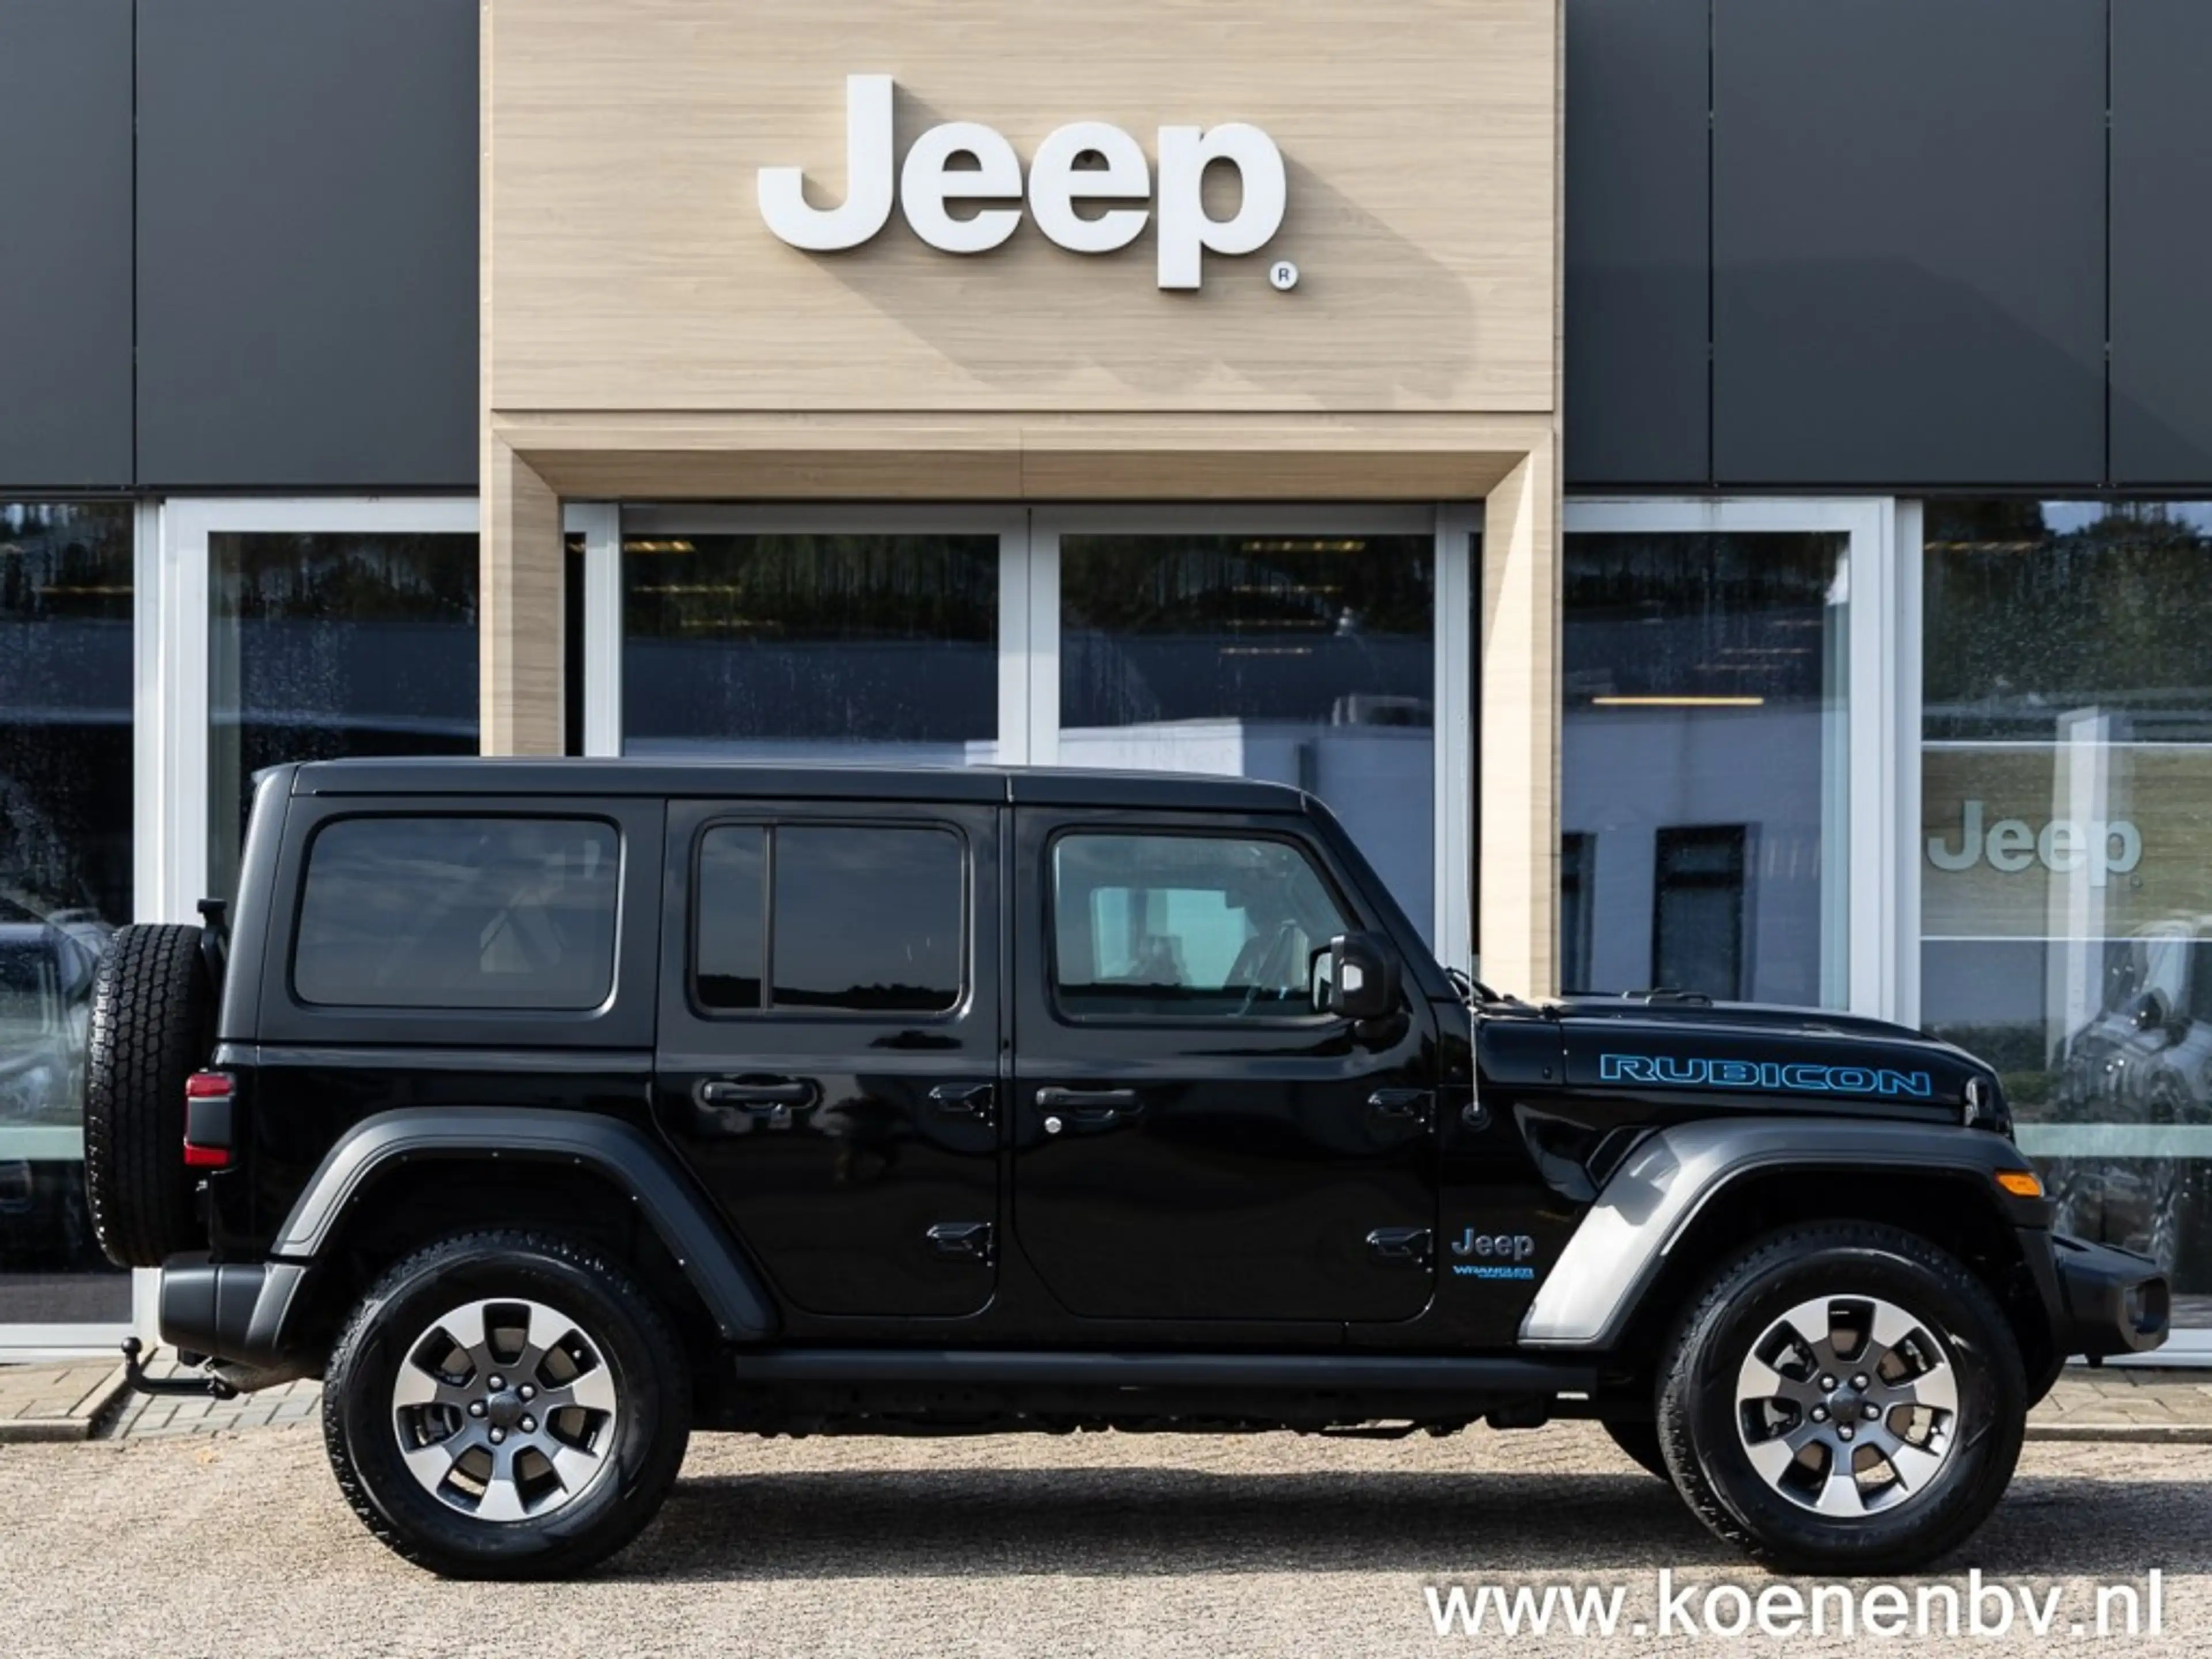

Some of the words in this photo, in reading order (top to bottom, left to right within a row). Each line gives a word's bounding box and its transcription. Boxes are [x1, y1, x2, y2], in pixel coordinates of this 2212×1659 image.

[757, 74, 1287, 290] Jeep
[1927, 800, 2142, 887] Jeep
[1600, 1054, 1931, 1096] RUBICON
[1451, 1228, 1535, 1262] Jeep
